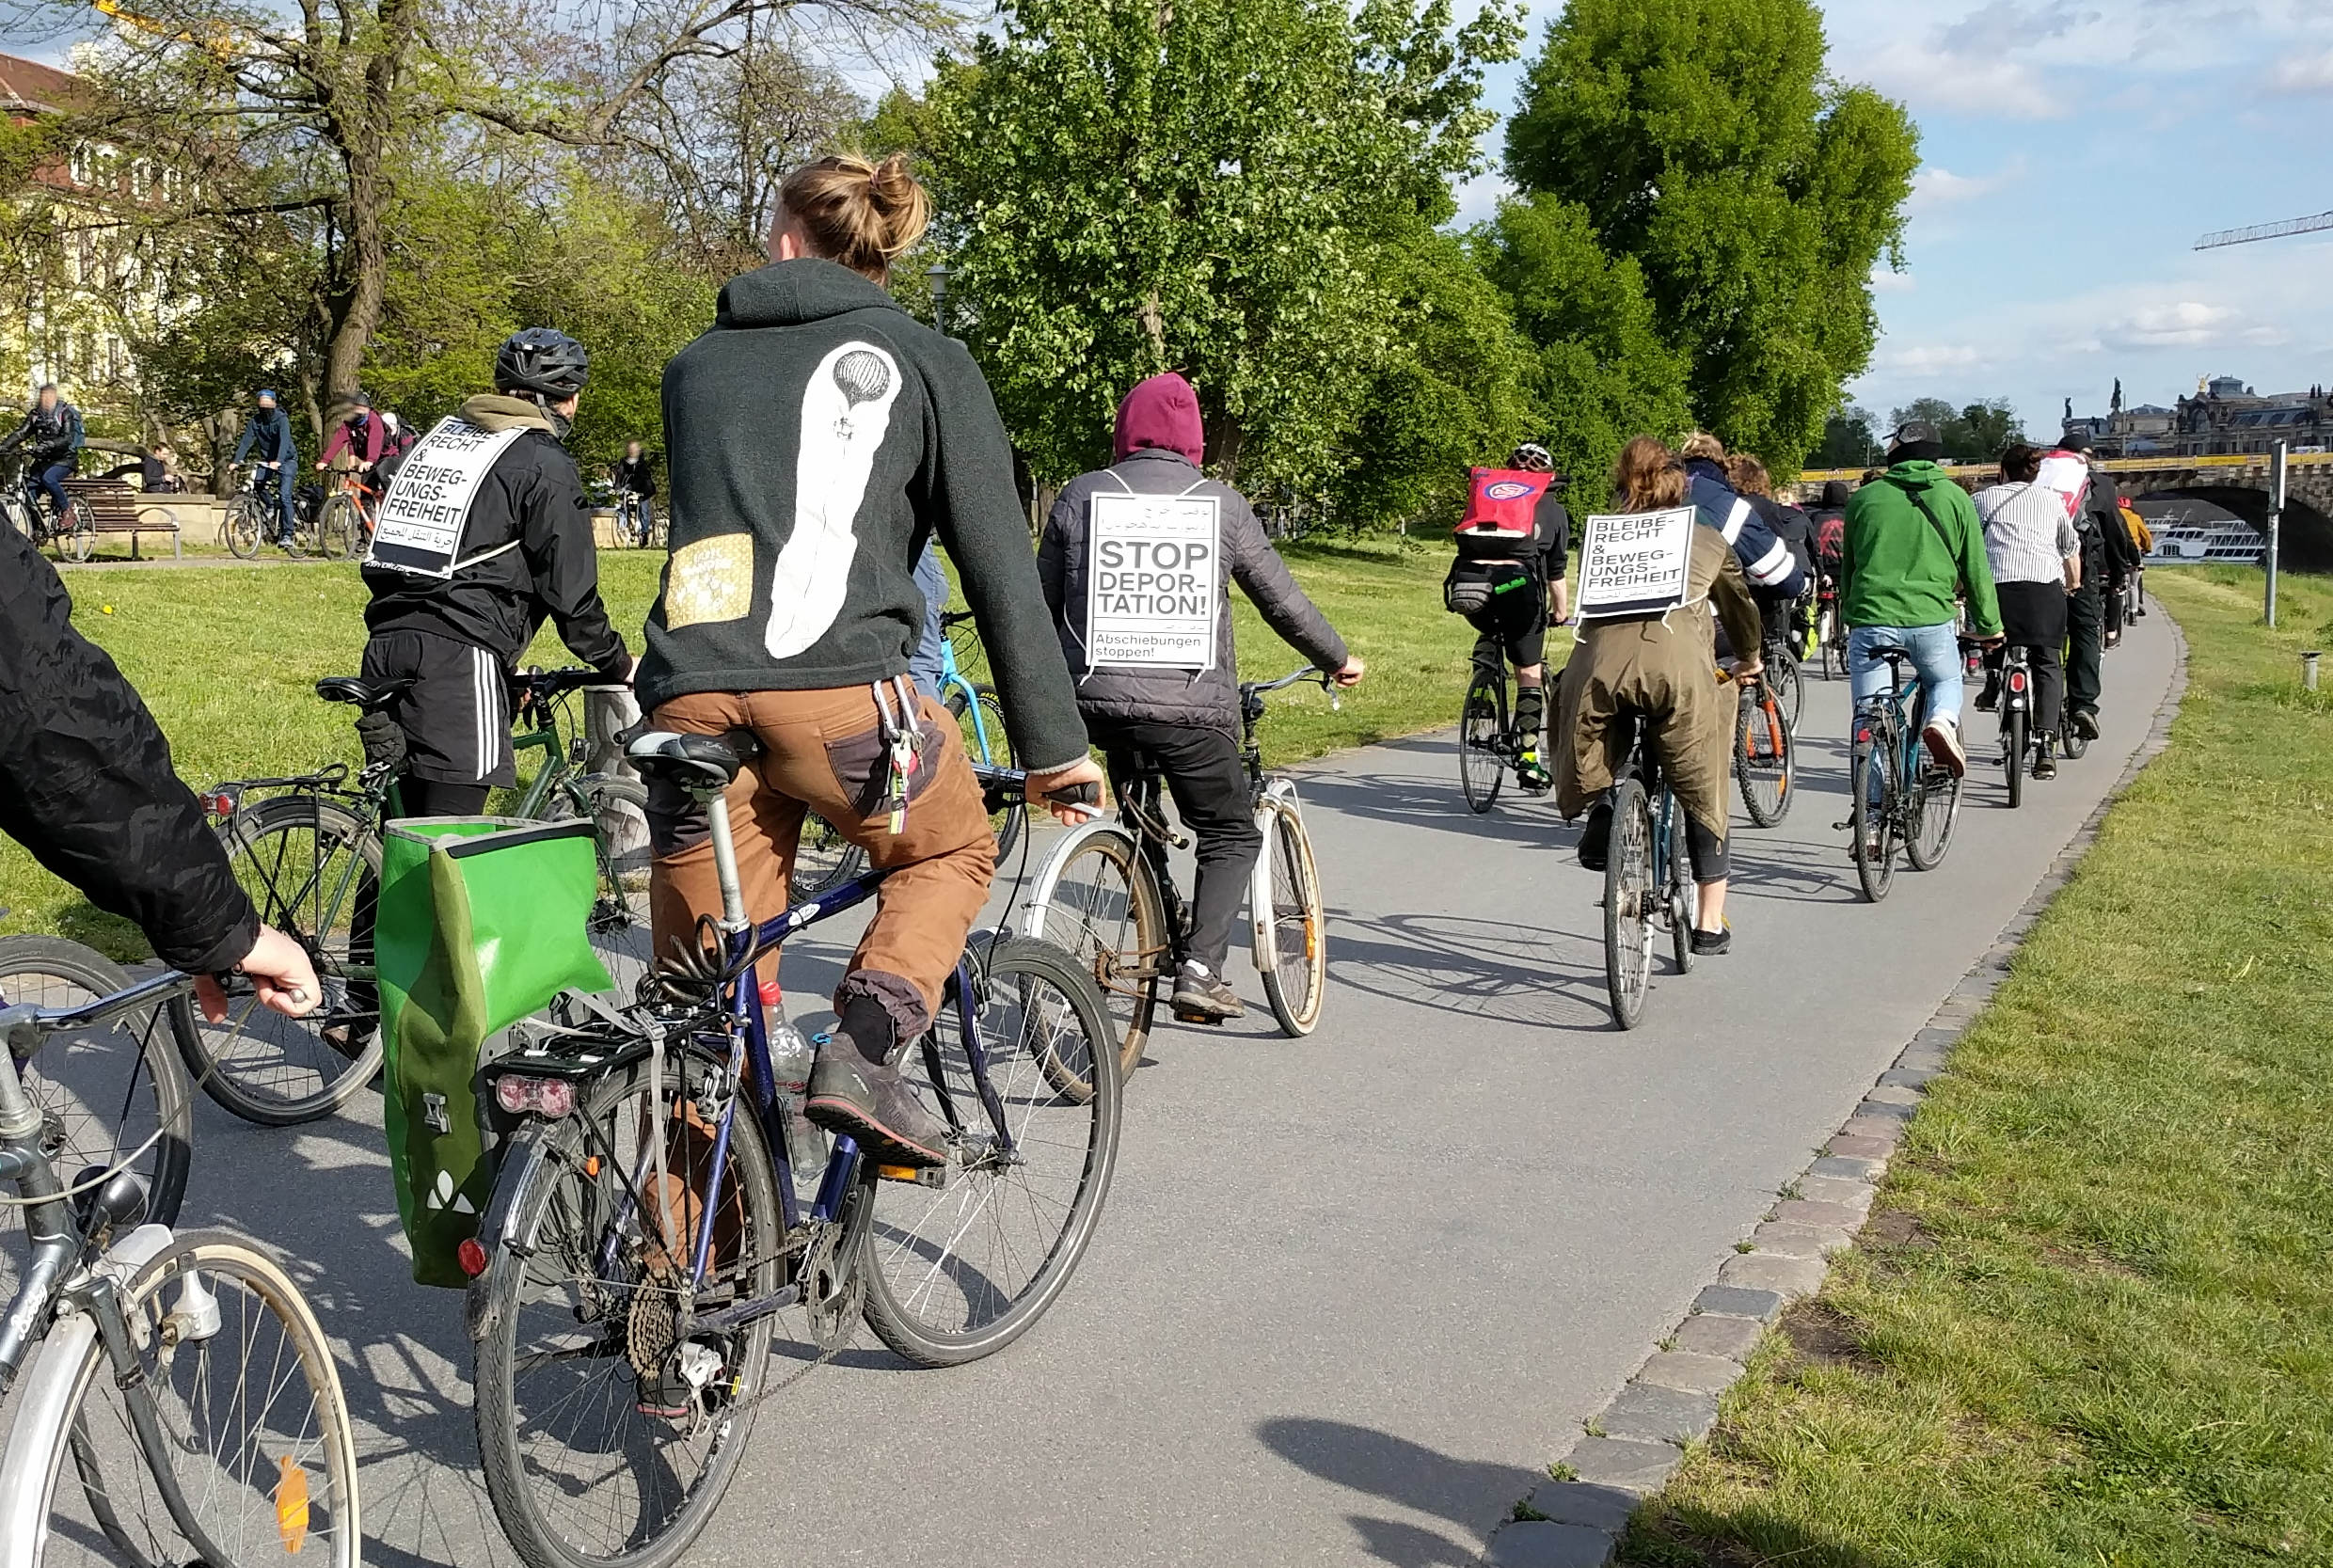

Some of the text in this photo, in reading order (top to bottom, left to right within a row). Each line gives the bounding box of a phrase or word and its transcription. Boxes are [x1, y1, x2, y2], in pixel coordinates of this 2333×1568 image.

[425, 436, 484, 452] RECHT
[414, 449, 427, 462] &
[404, 464, 468, 485] BEWEG-
[395, 480, 447, 502] UNGS-
[387, 498, 461, 525] FREIHEIT
[1595, 516, 1674, 531] BLEIBE-
[1595, 528, 1663, 543] RECHT
[1099, 540, 1209, 570] STOP
[1592, 545, 1605, 555] &
[1592, 549, 1674, 565] BEWEG-
[1588, 568, 1681, 588] FREIHEIT
[1590, 562, 1657, 578] UNGS-
[1099, 572, 1206, 594] DEPOR-
[1097, 594, 1206, 615] TATION!
[1096, 633, 1200, 649] Abschiebungen
[1095, 646, 1154, 658] stoppen!
